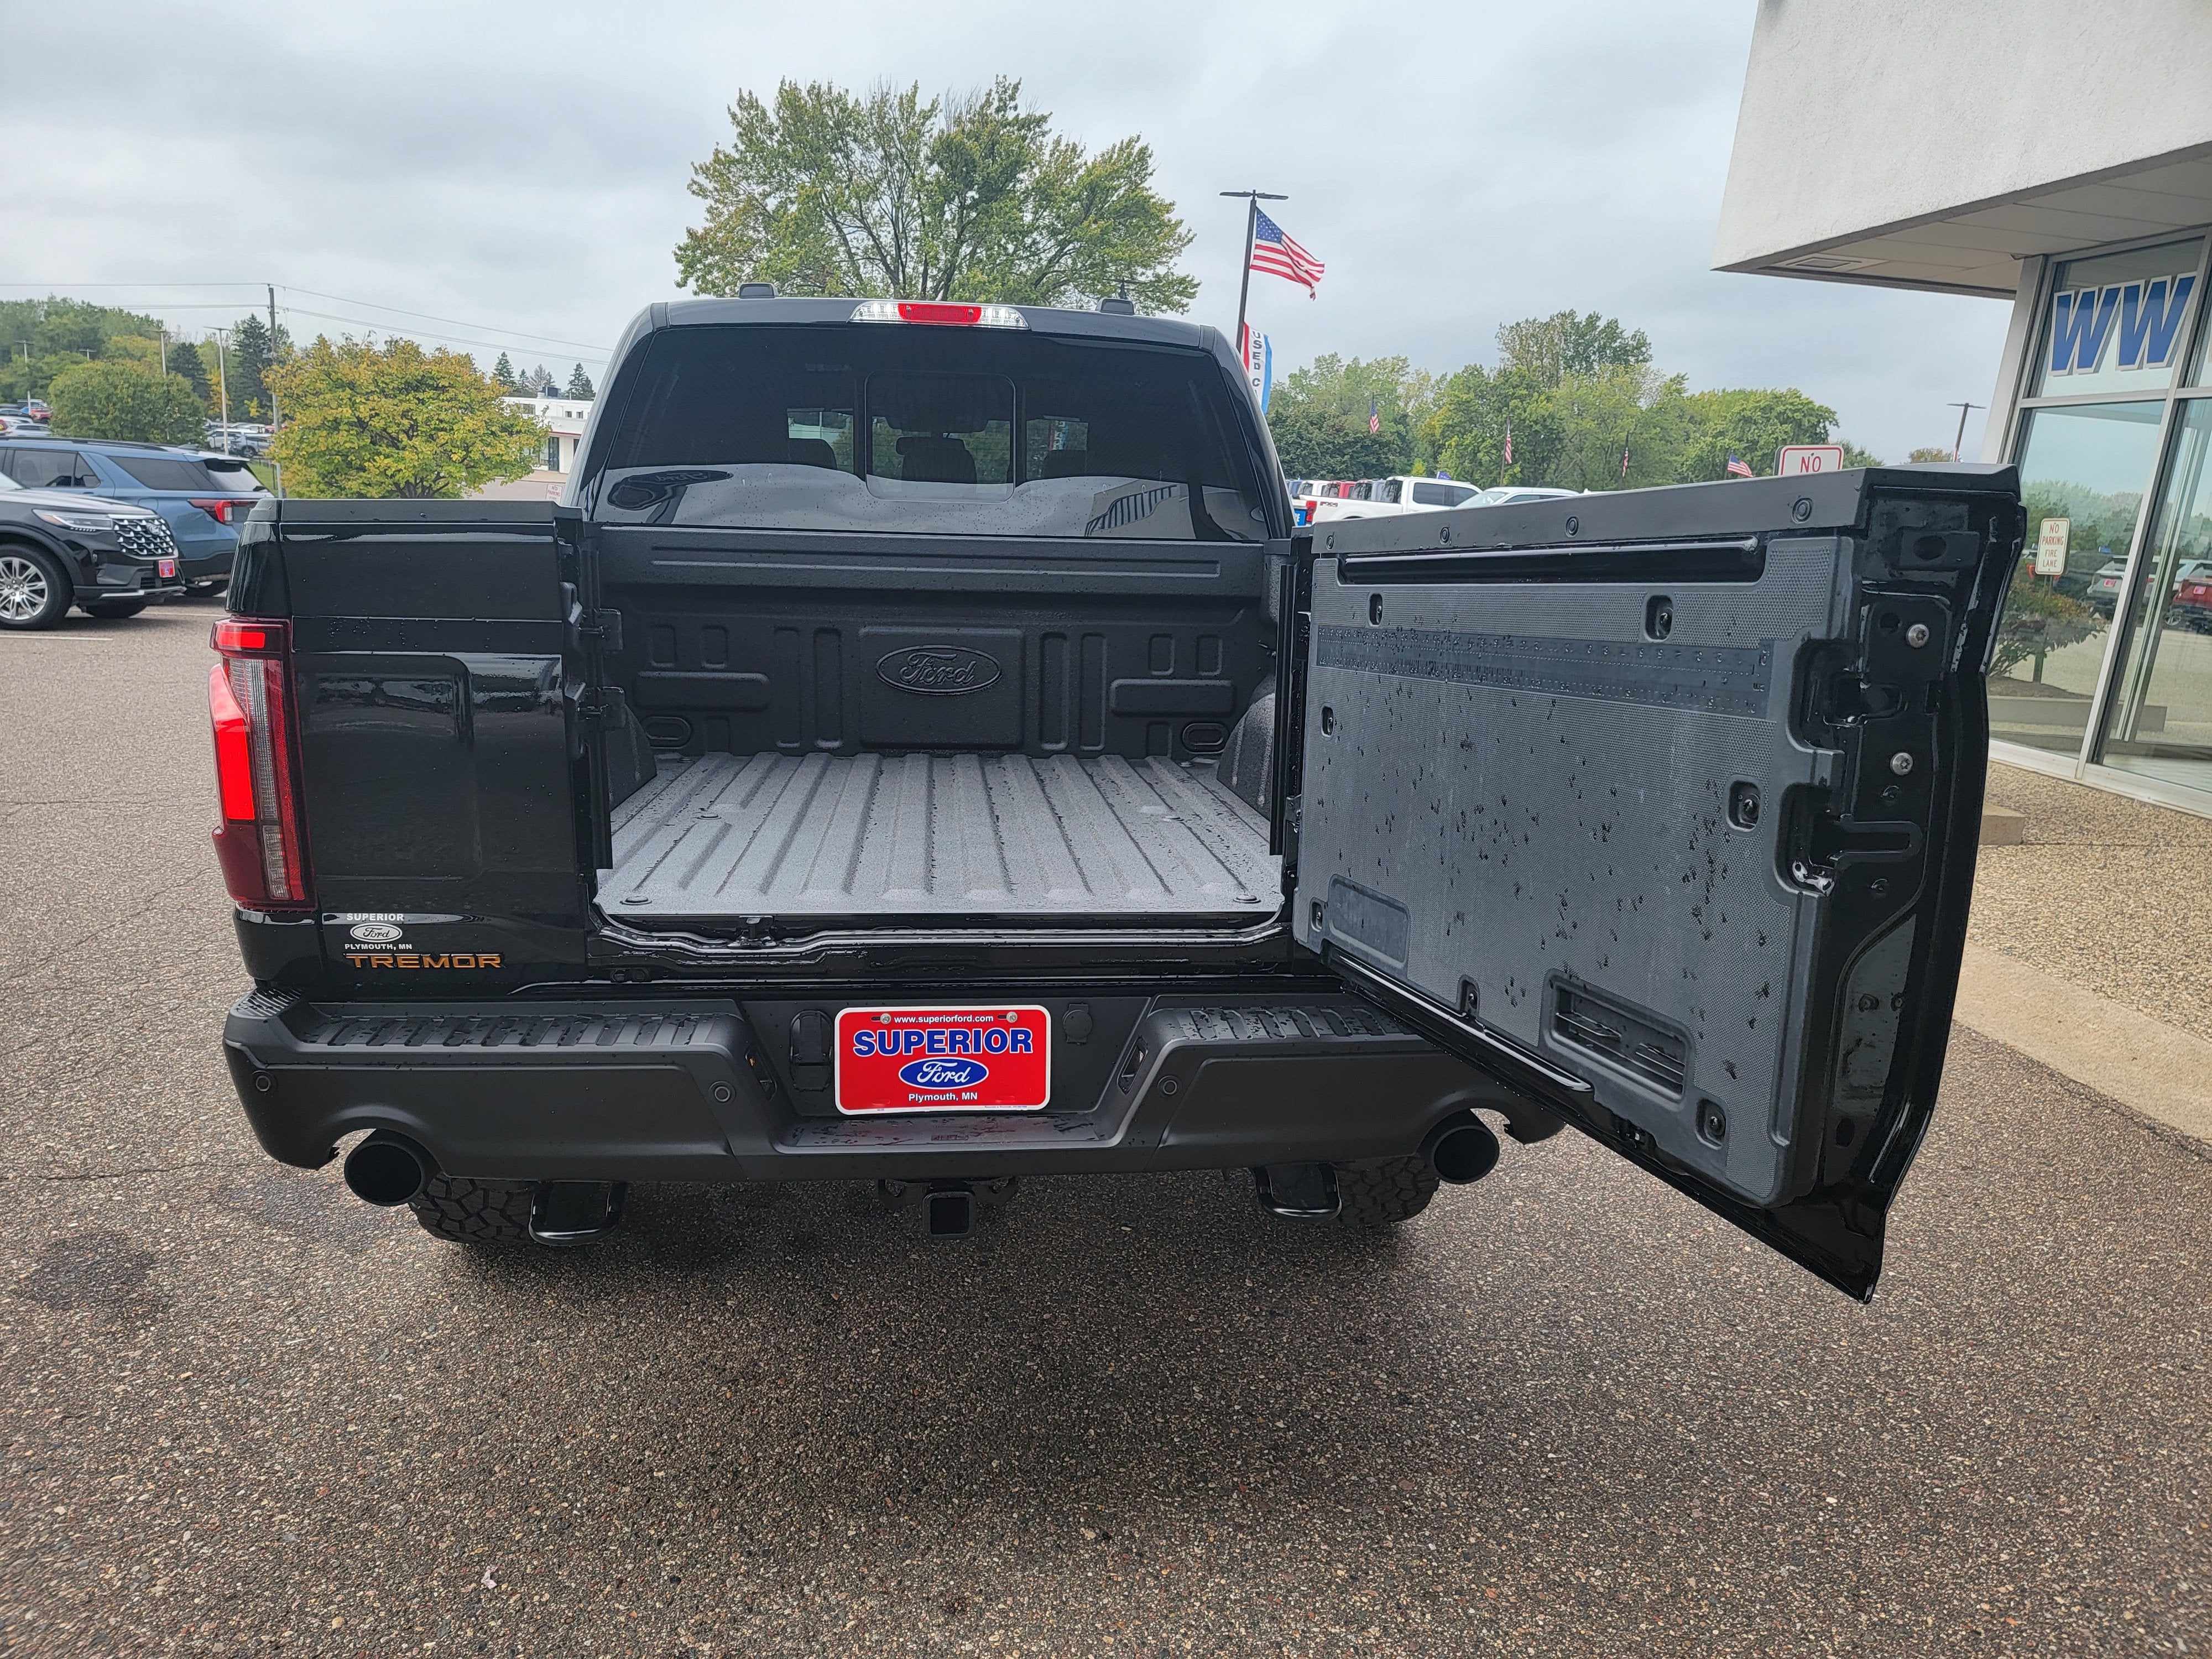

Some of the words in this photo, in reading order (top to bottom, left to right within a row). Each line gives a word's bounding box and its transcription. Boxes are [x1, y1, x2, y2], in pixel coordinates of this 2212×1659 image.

[1252, 331, 1262, 370] USED
[1800, 456, 1822, 473] NO
[2049, 524, 2059, 534] NO
[2042, 536, 2064, 546] PARKING
[2042, 560, 2057, 568] LANE
[899, 651, 977, 685] Ford
[346, 913, 404, 921] SUPERIOR
[362, 927, 390, 938] Ford
[345, 953, 502, 968] TREMOR
[894, 1014, 994, 1025] www.superiorford.com
[853, 1027, 1034, 1057] SUPERIOR
[917, 1061, 972, 1084] Ford
[908, 1093, 958, 1103] Plymouth,
[961, 1092, 978, 1101] MN
